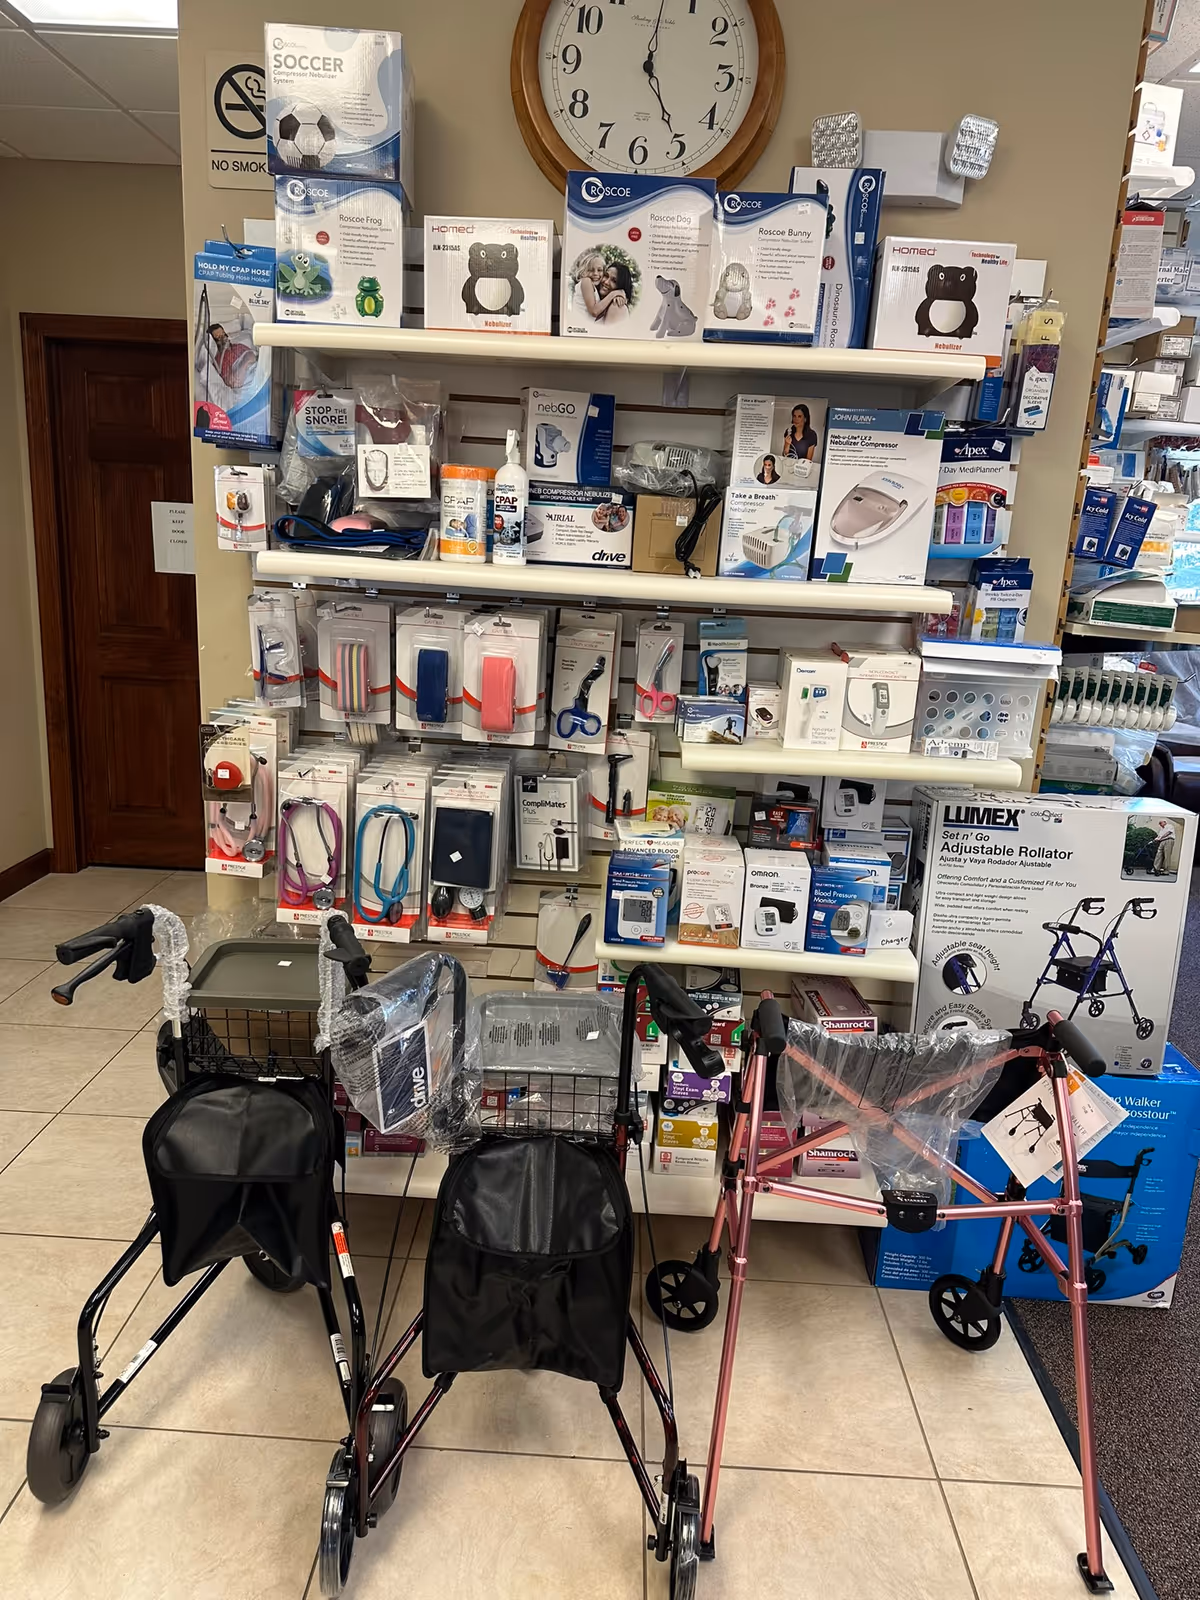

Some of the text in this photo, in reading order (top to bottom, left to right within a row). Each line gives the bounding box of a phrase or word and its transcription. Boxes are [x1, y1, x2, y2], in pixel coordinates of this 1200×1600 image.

[578, 5, 604, 35] 10
[710, 16, 728, 47] 2
[273, 54, 344, 72] SOCCER
[562, 44, 582, 75] 9
[273, 70, 337, 80] Compressor Nebulizer
[714, 64, 734, 92] 3
[569, 88, 590, 118] 8
[698, 102, 719, 130] 4
[598, 122, 616, 150] 7
[628, 136, 648, 165] 6
[666, 133, 686, 160] 5
[212, 161, 267, 173] NO SMOK
[340, 214, 382, 226] Roscoe Frog
[650, 214, 692, 225] Roscoe Dog
[758, 228, 812, 238] Roscoe Bunny
[981, 258, 998, 266] Healthy
[198, 262, 270, 276] HOLD MY CPAP HOSE
[1174, 266, 1190, 274] Male
[198, 270, 270, 284] CPAP Tubing Hose Holder
[831, 283, 843, 327] Dinosaurio
[484, 320, 512, 328] Nebulizer
[934, 342, 962, 350] Nebulizer
[305, 406, 332, 414] STOP
[537, 402, 576, 414] nebGO
[305, 416, 348, 424] SNORE!
[860, 441, 898, 450] Compressor
[959, 443, 988, 458] Apex
[939, 466, 957, 474] 7-Day
[543, 488, 584, 496] COMPRESSOR
[444, 495, 475, 505] CPAP
[495, 496, 518, 504] CPAP
[730, 500, 765, 508] Compressor
[1086, 505, 1109, 514] Icy Cold
[546, 513, 575, 522] AIRIAL
[1134, 515, 1147, 524] Cold
[592, 550, 626, 562] drive
[998, 578, 1019, 587] Apex
[705, 806, 716, 817] 120
[704, 817, 714, 828] 80
[942, 831, 990, 842] Set Go
[940, 842, 1073, 860] Adjustable Rollator
[969, 857, 986, 865] Vaya
[988, 858, 1017, 866] Rodador
[1019, 860, 1052, 868] Ajustable
[751, 870, 780, 878] OMRON
[937, 873, 962, 882] Offering
[963, 875, 988, 883] Comfort
[1009, 878, 1044, 886] Customized
[881, 936, 908, 945] Charger
[931, 940, 1001, 972] Adjustable seat height
[935, 1005, 947, 1016] and
[948, 1002, 966, 1011] Easy
[967, 1004, 986, 1019] Brake
[823, 1021, 871, 1029] Shamrock
[649, 1028, 655, 1036] L
[410, 1066, 424, 1107] drive
[1124, 1096, 1161, 1108] Walker
[808, 1149, 855, 1158] Shamrock
